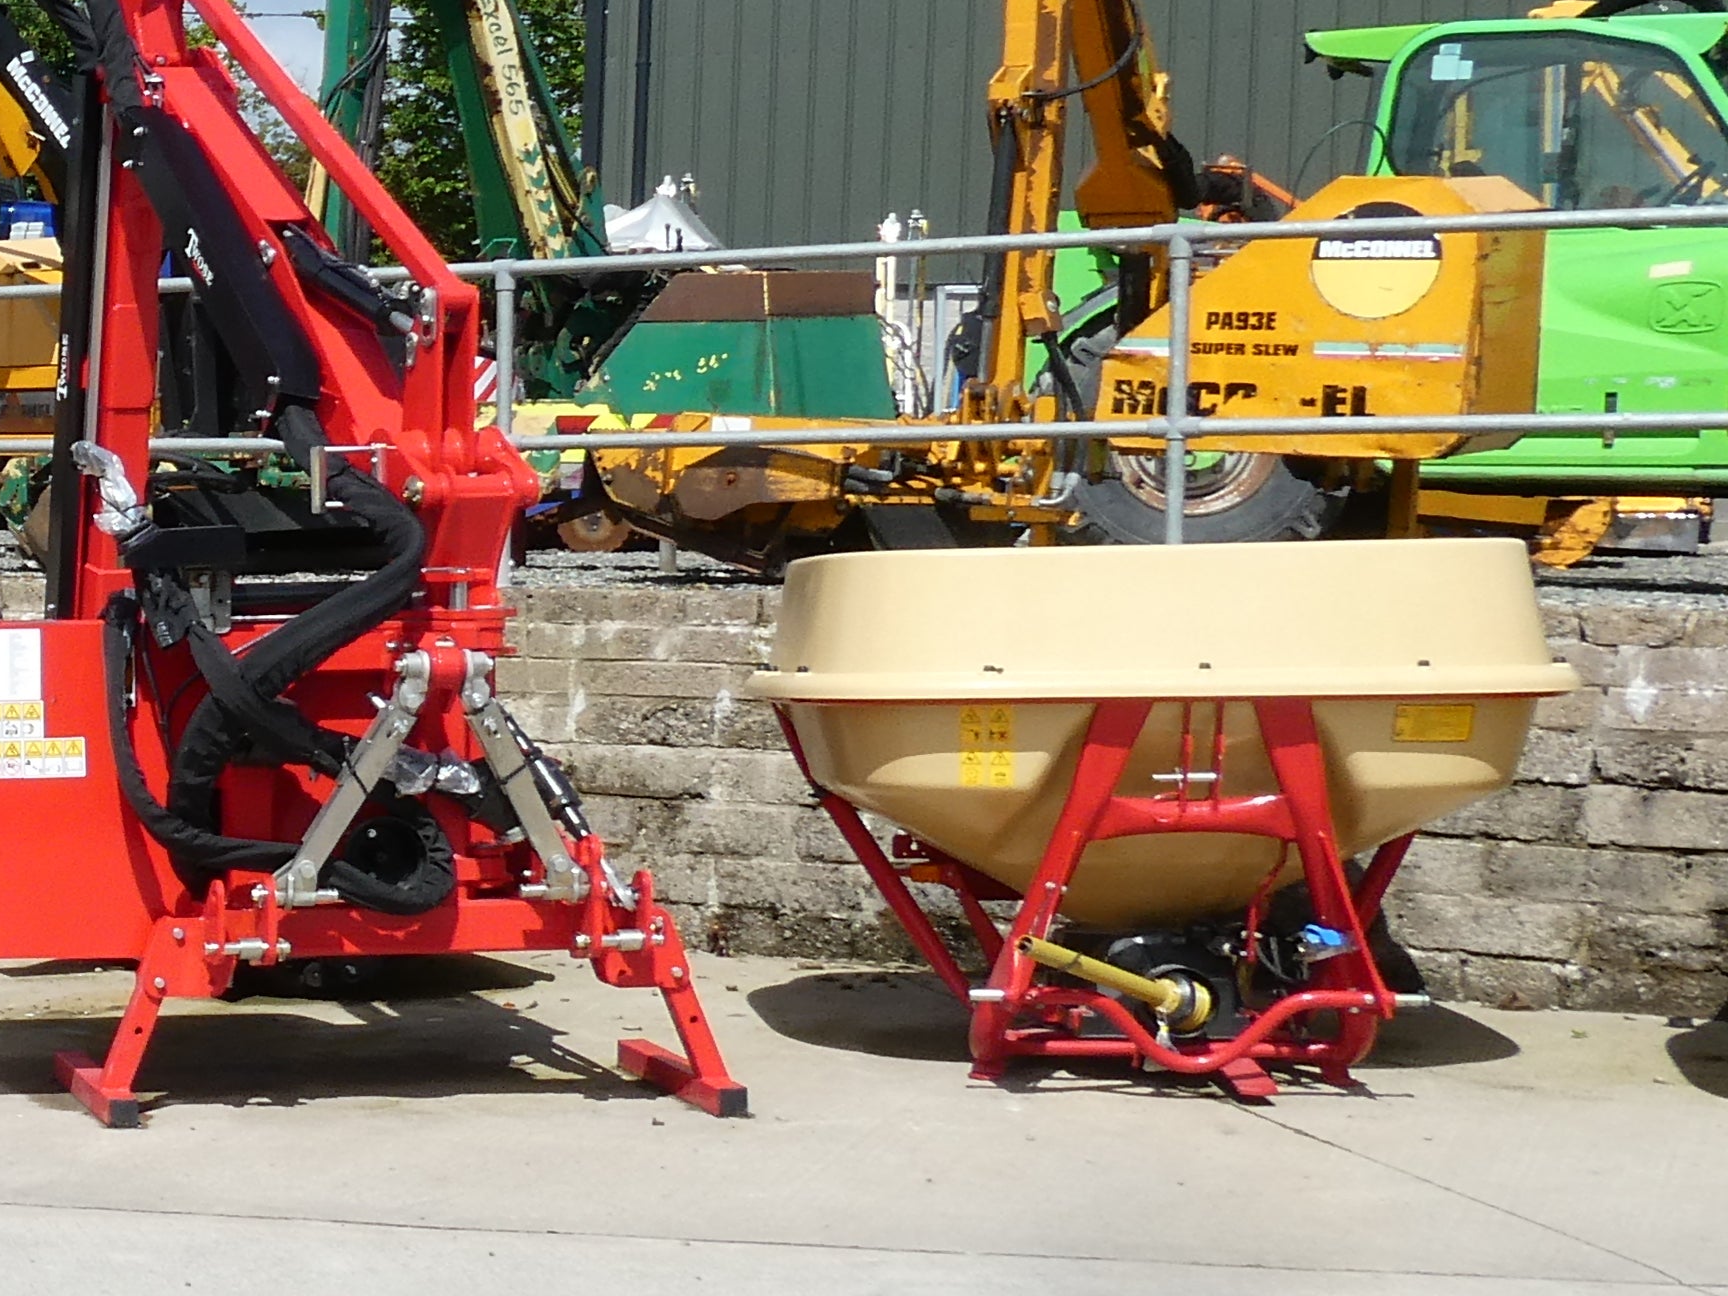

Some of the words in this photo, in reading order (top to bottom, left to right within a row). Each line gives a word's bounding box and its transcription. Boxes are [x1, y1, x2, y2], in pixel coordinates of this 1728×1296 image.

[1205, 311, 1278, 331] PA93E
[1189, 341, 1246, 356] SUPER
[1252, 342, 1299, 357] SLEW
